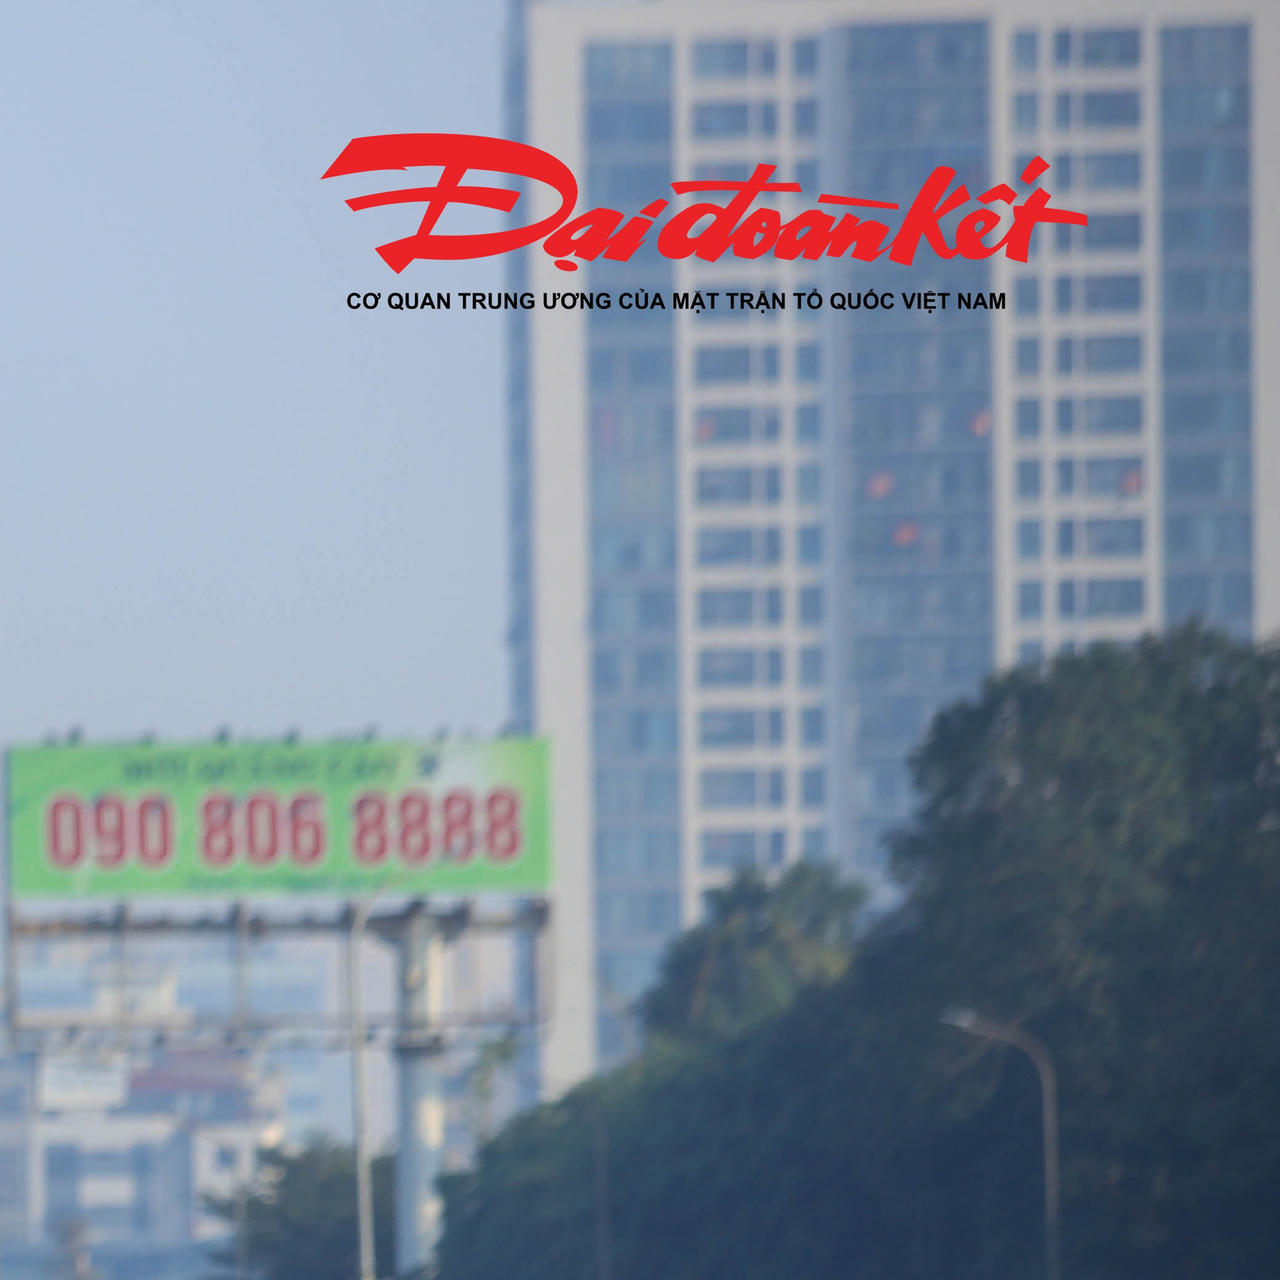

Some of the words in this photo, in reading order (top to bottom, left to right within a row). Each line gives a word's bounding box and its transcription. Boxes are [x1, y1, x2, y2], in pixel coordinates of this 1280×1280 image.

[48, 792, 175, 870] 090
[200, 790, 327, 868] 806
[352, 788, 523, 867] 8888
